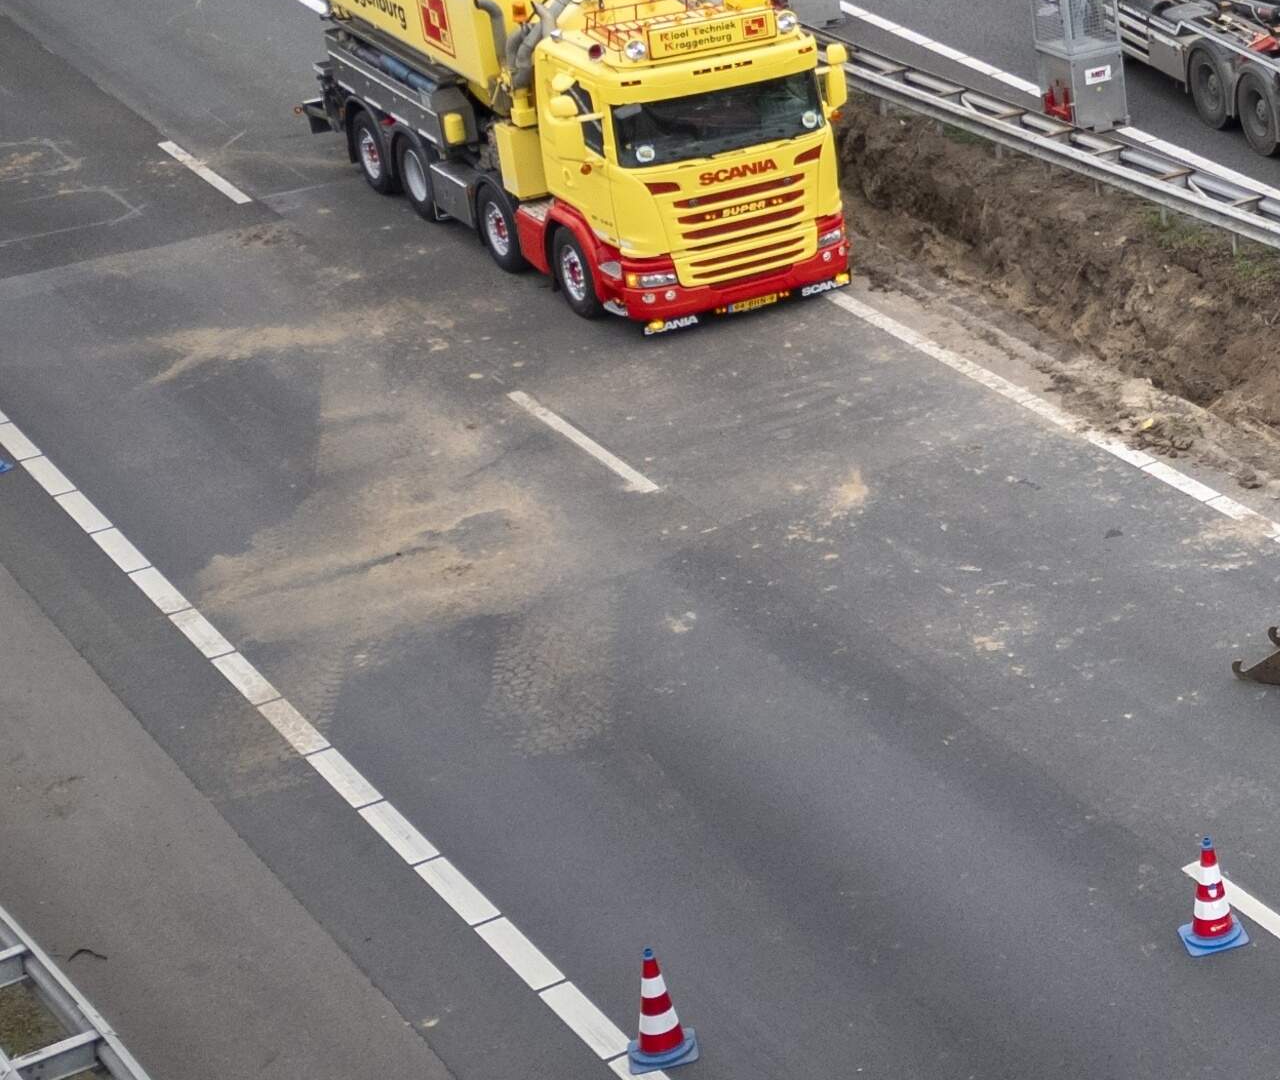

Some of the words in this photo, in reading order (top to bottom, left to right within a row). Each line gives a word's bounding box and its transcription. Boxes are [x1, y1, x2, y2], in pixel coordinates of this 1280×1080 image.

[660, 30, 689, 42] Riool
[693, 20, 737, 35] Techniek
[664, 32, 732, 51] Kraggenburg
[699, 159, 778, 186] SCANIA
[722, 199, 766, 218] SUPER
